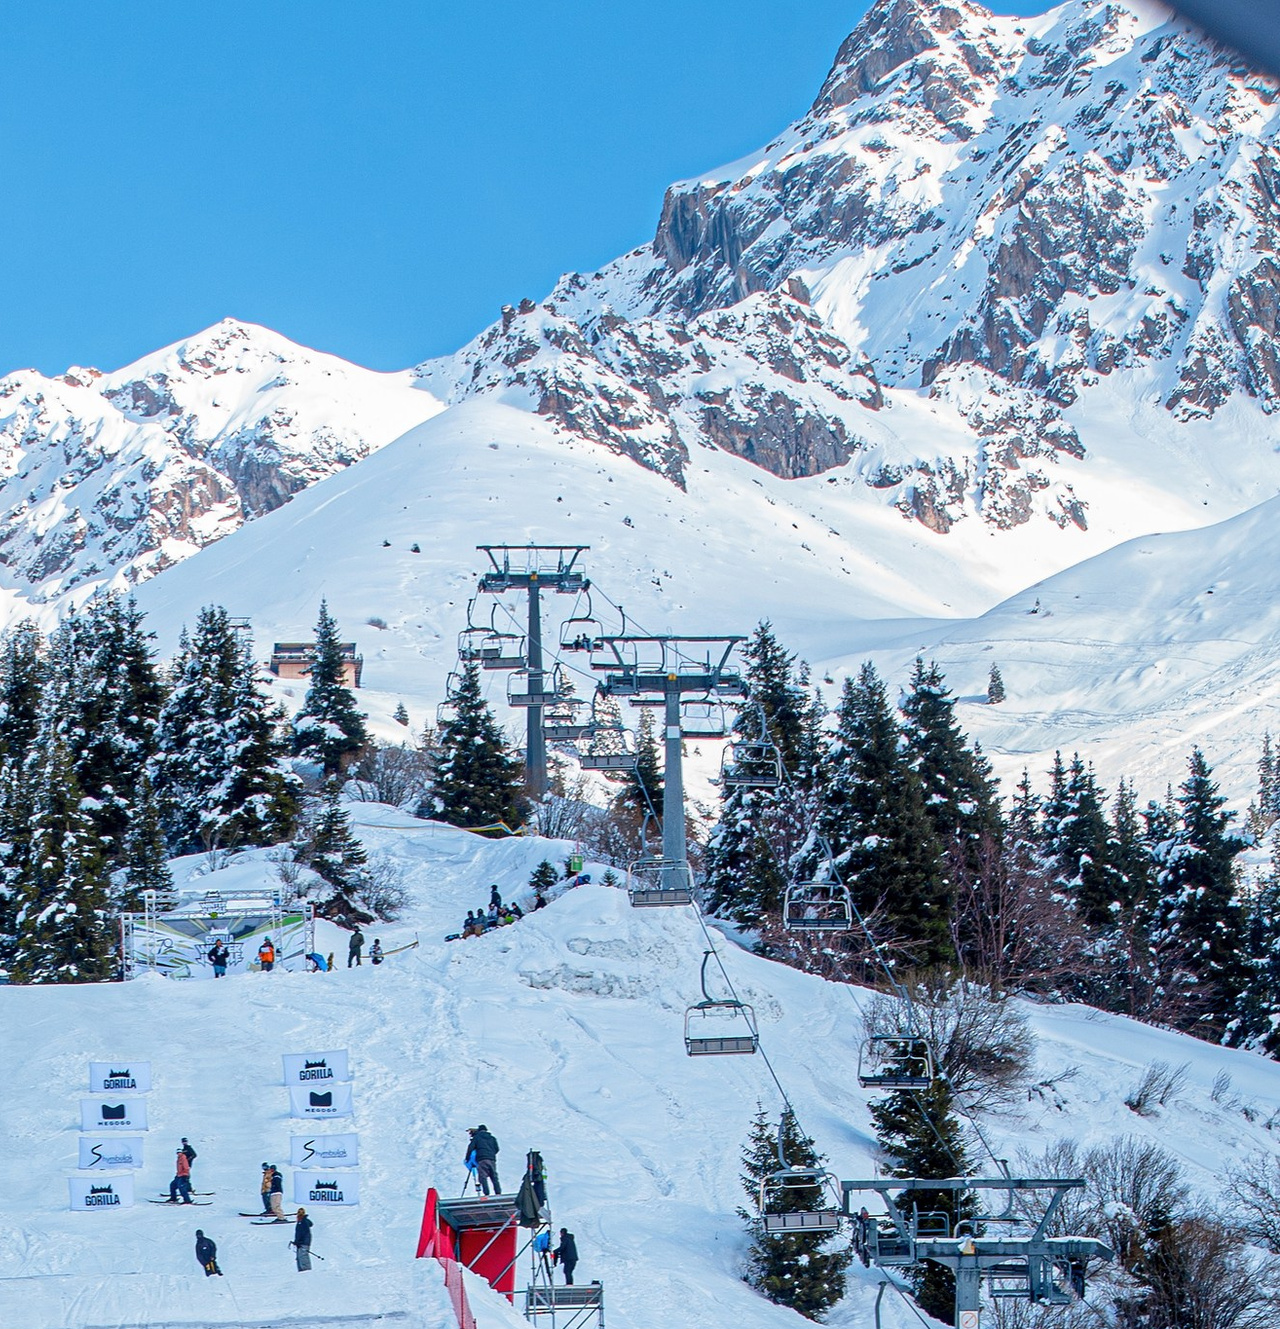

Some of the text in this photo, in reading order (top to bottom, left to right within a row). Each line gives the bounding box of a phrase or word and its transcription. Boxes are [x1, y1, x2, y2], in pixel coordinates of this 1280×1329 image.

[299, 1067, 333, 1081] GORILLA
[104, 1079, 136, 1089] GORILLA
[85, 1195, 120, 1206] GORILLA
[309, 1191, 344, 1202] GORILLA
